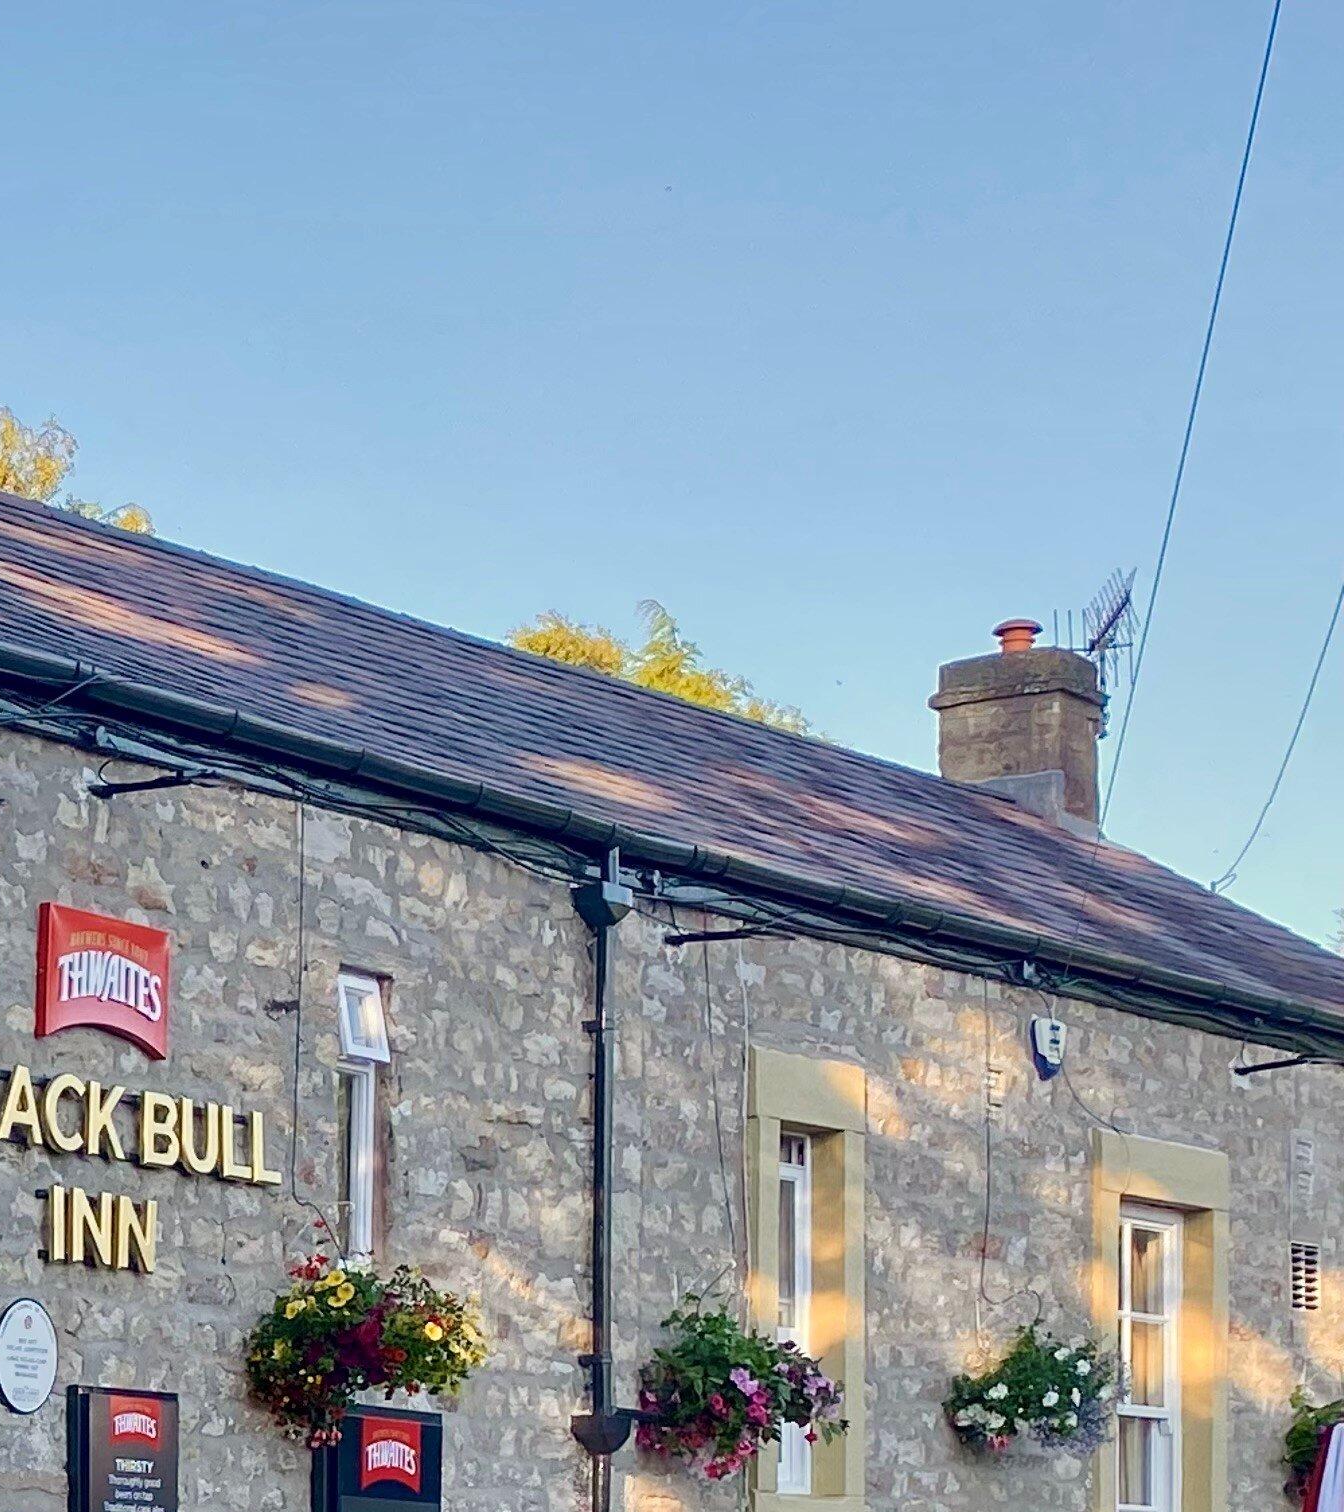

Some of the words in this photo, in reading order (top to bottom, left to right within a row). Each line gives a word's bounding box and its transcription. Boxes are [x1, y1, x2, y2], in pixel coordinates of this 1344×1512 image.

[57, 950, 161, 1022] THWAITES
[139, 1090, 283, 1186] BULL
[48, 1184, 158, 1274] INN
[113, 1412, 157, 1438] THWAITES
[115, 1458, 154, 1473] THIRSTY
[365, 1439, 416, 1475] THWAITES
